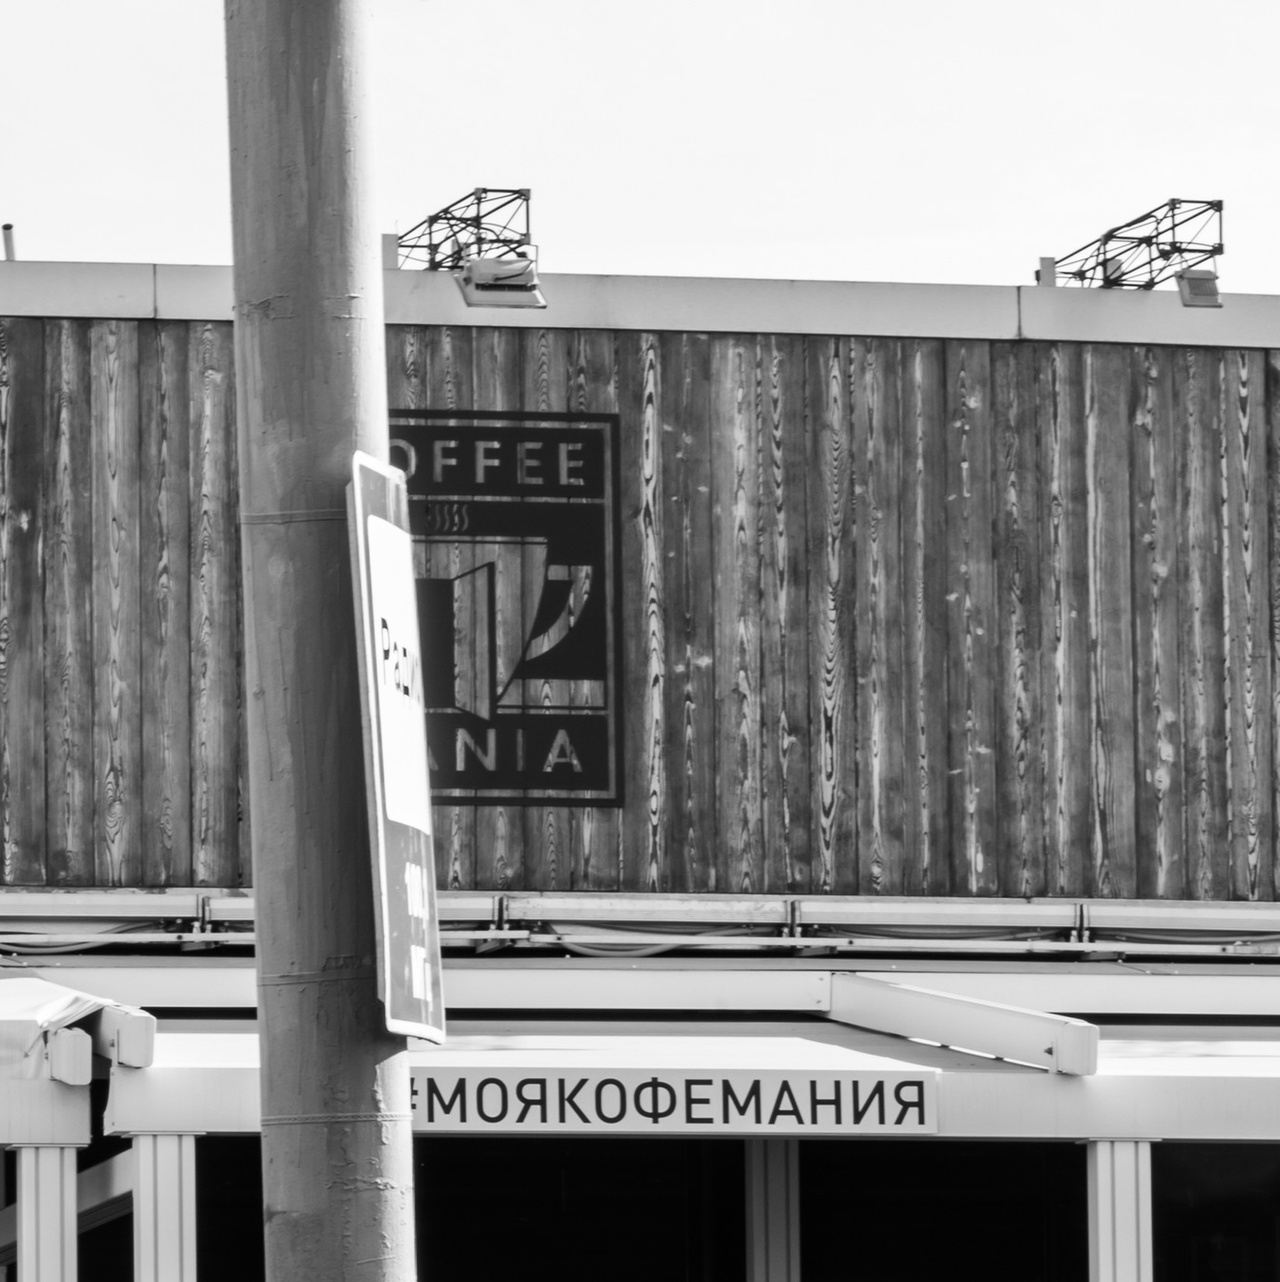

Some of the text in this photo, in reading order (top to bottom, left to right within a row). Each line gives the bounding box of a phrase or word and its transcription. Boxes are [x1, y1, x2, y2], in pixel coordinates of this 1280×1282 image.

[390, 439, 586, 486] OFFEE
[429, 728, 583, 773] NIA
[411, 1077, 926, 1126] МОЯКОФЕМАНИЯ
